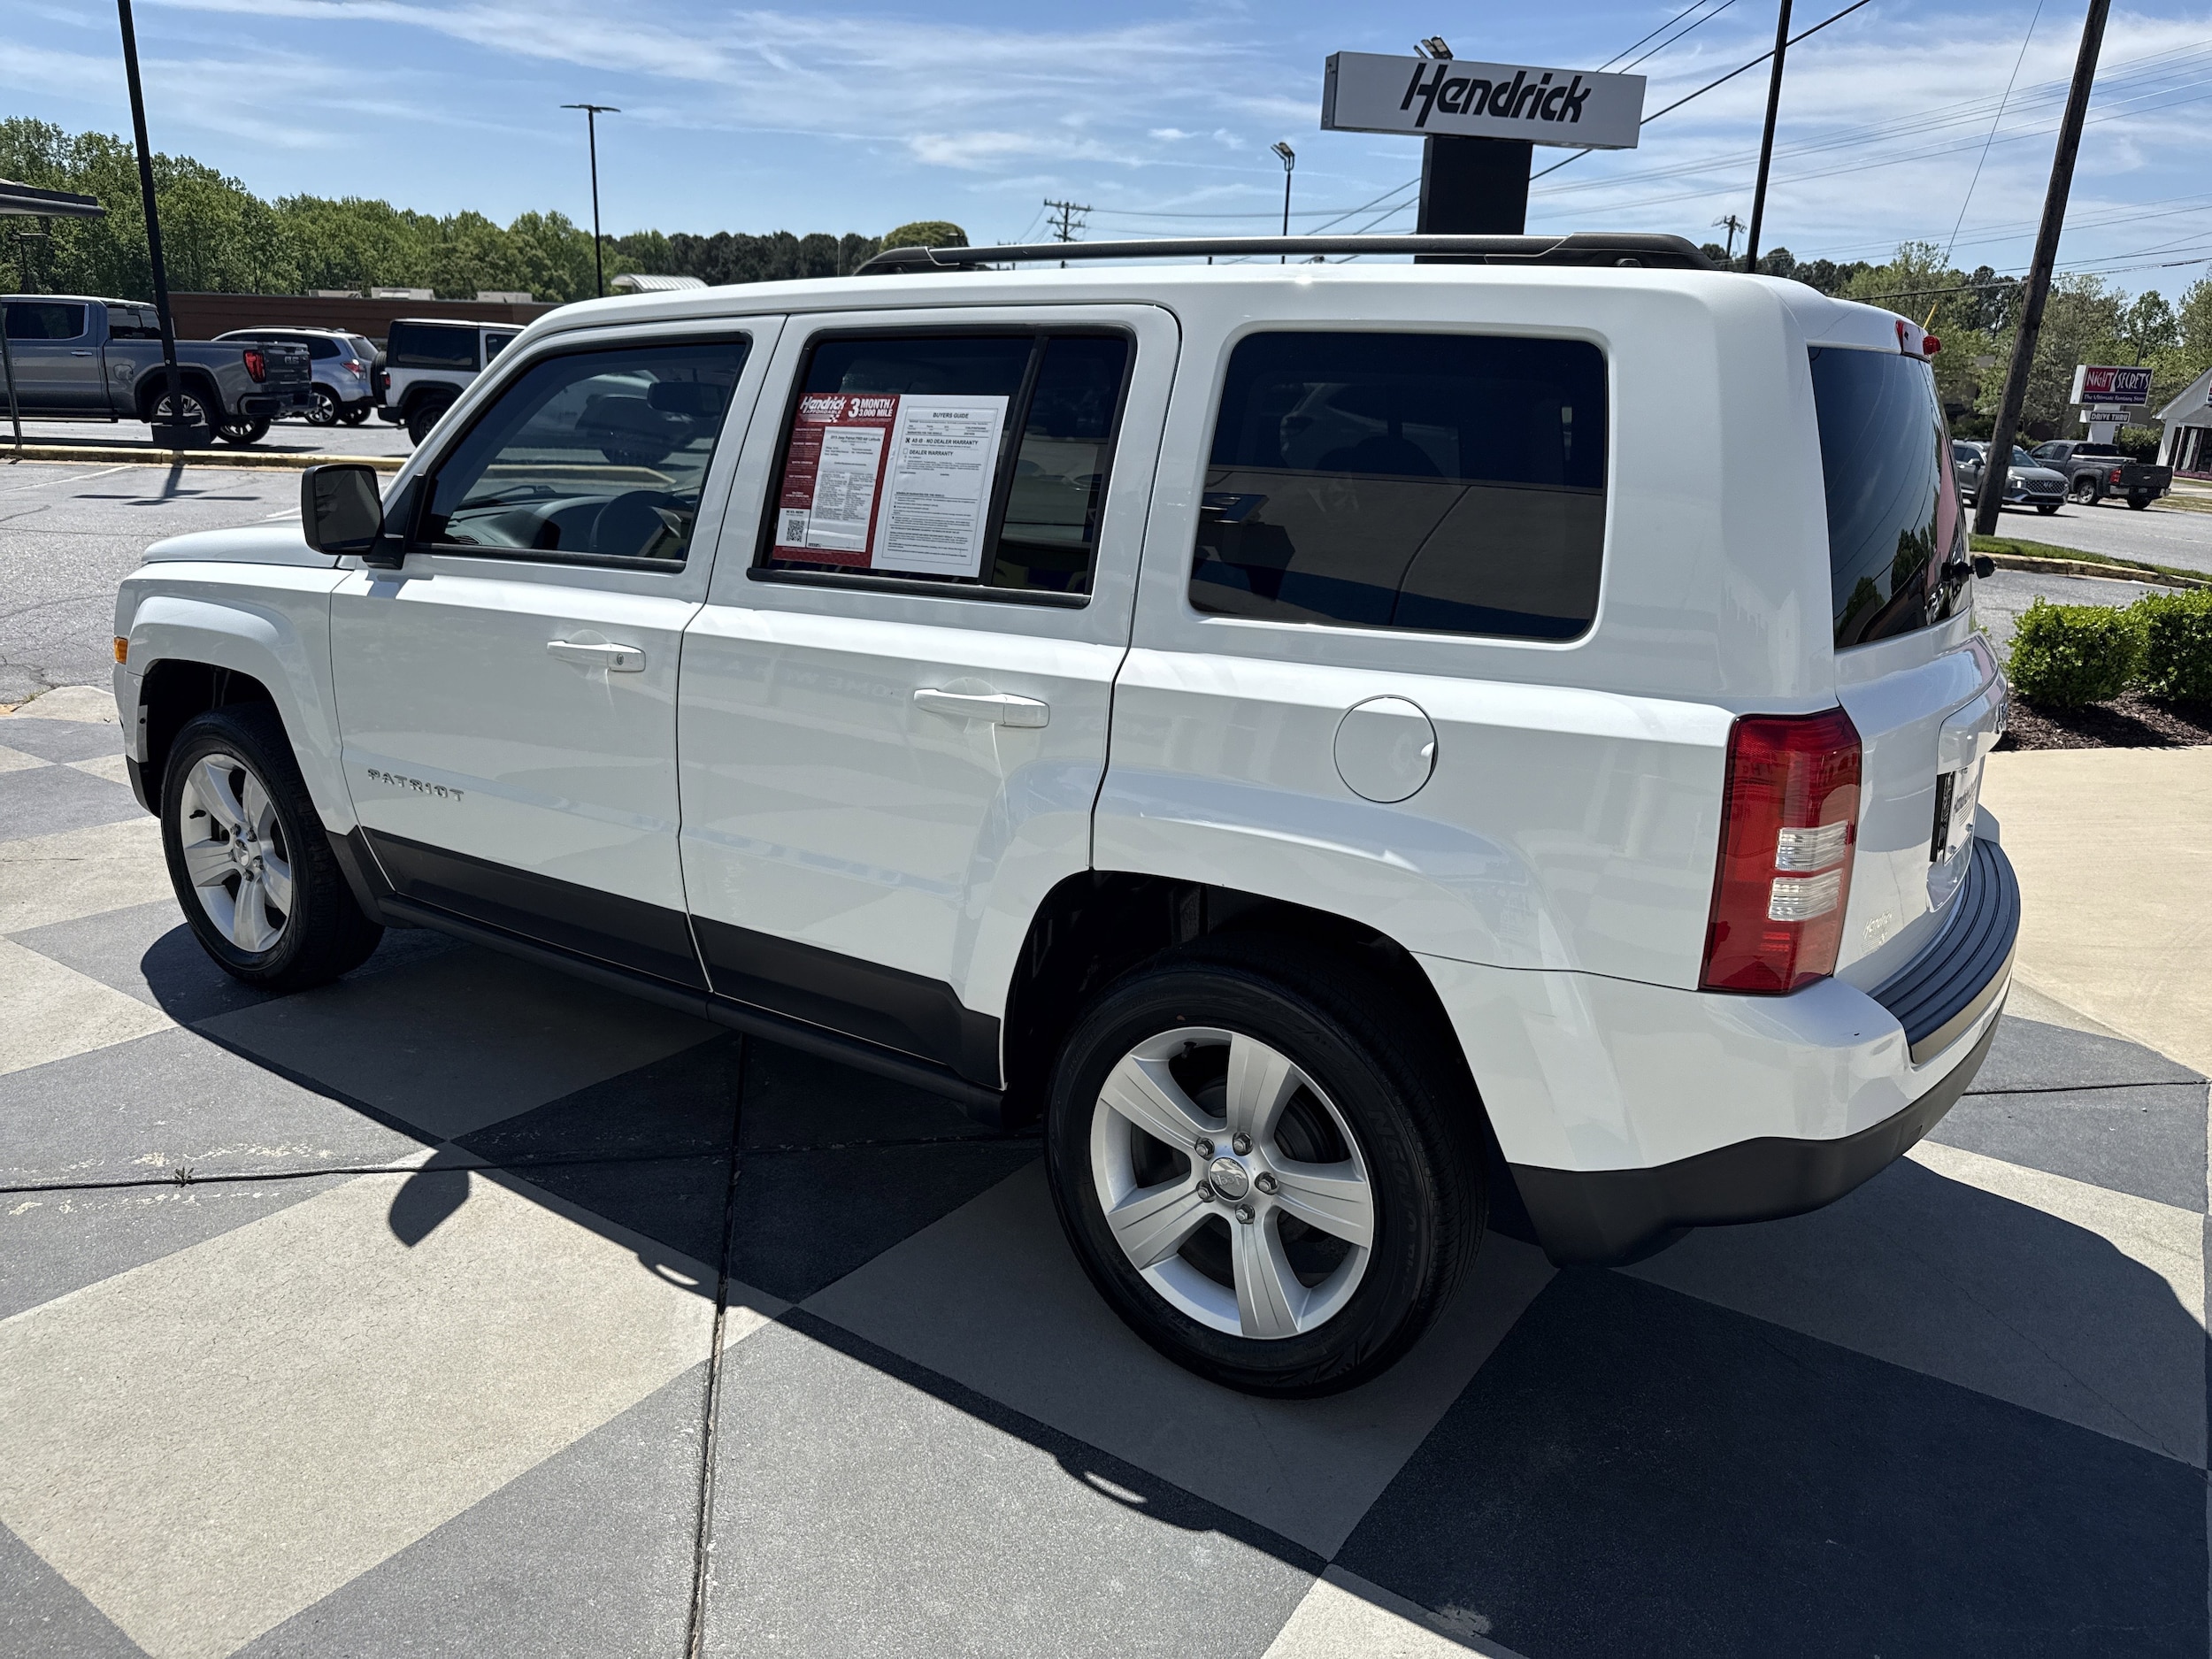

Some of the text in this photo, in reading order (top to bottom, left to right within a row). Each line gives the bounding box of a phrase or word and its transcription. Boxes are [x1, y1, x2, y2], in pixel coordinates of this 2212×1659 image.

[1400, 62, 1592, 127] Hendrick
[2116, 373, 2150, 389] SECRETS
[800, 396, 847, 414] Hendrick
[849, 397, 861, 418] 3
[877, 409, 893, 418] MILE
[368, 768, 465, 802] PATRIOT
